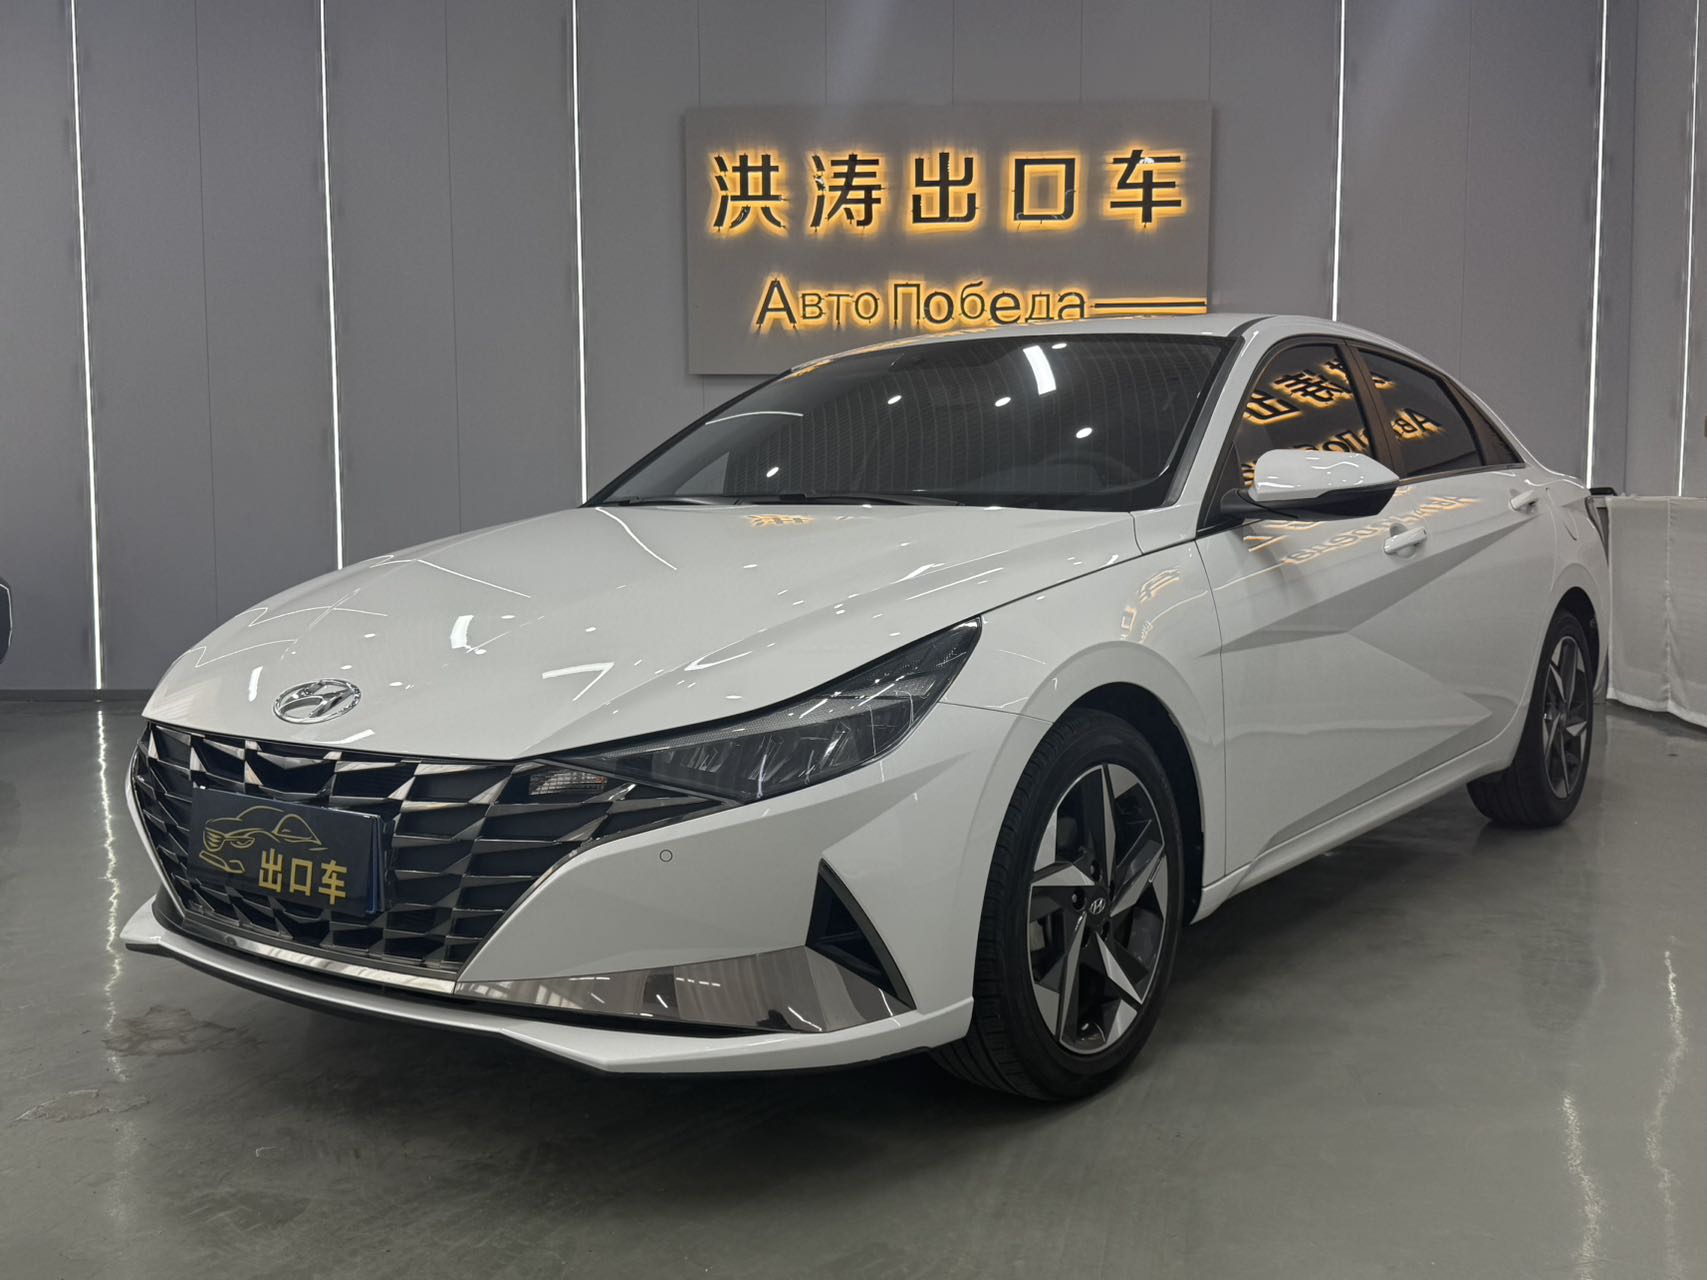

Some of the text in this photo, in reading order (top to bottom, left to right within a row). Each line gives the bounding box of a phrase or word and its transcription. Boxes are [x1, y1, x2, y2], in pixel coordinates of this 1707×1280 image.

[713, 149, 1183, 227] 洪涛出口车
[258, 848, 348, 905] 出口车
